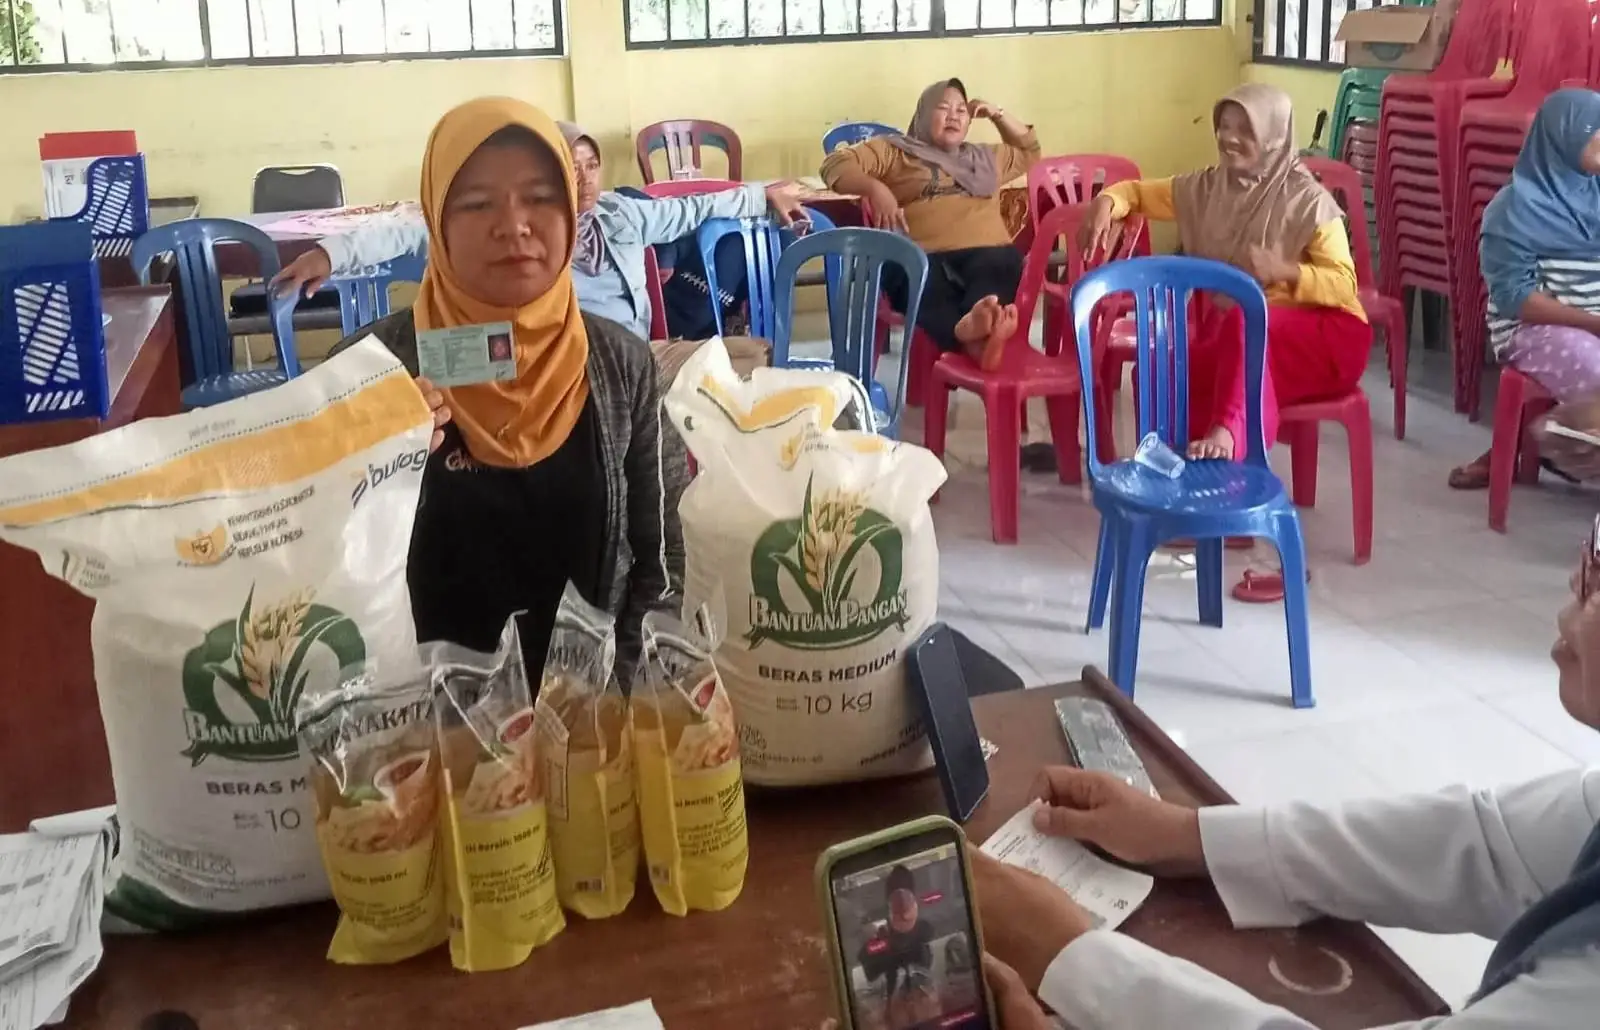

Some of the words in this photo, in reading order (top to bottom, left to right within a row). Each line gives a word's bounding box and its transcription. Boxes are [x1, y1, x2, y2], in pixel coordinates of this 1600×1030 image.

[369, 449, 428, 489] bulog
[748, 595, 834, 633] BANTUAN
[839, 589, 908, 630] PANGAN
[758, 665, 822, 683] BERAS
[829, 649, 896, 682] MEDIUM
[804, 694, 832, 715] 10
[842, 690, 872, 713] kg
[183, 707, 290, 745] BANTUAN
[206, 780, 283, 796] BERAS
[264, 807, 301, 833] 10
